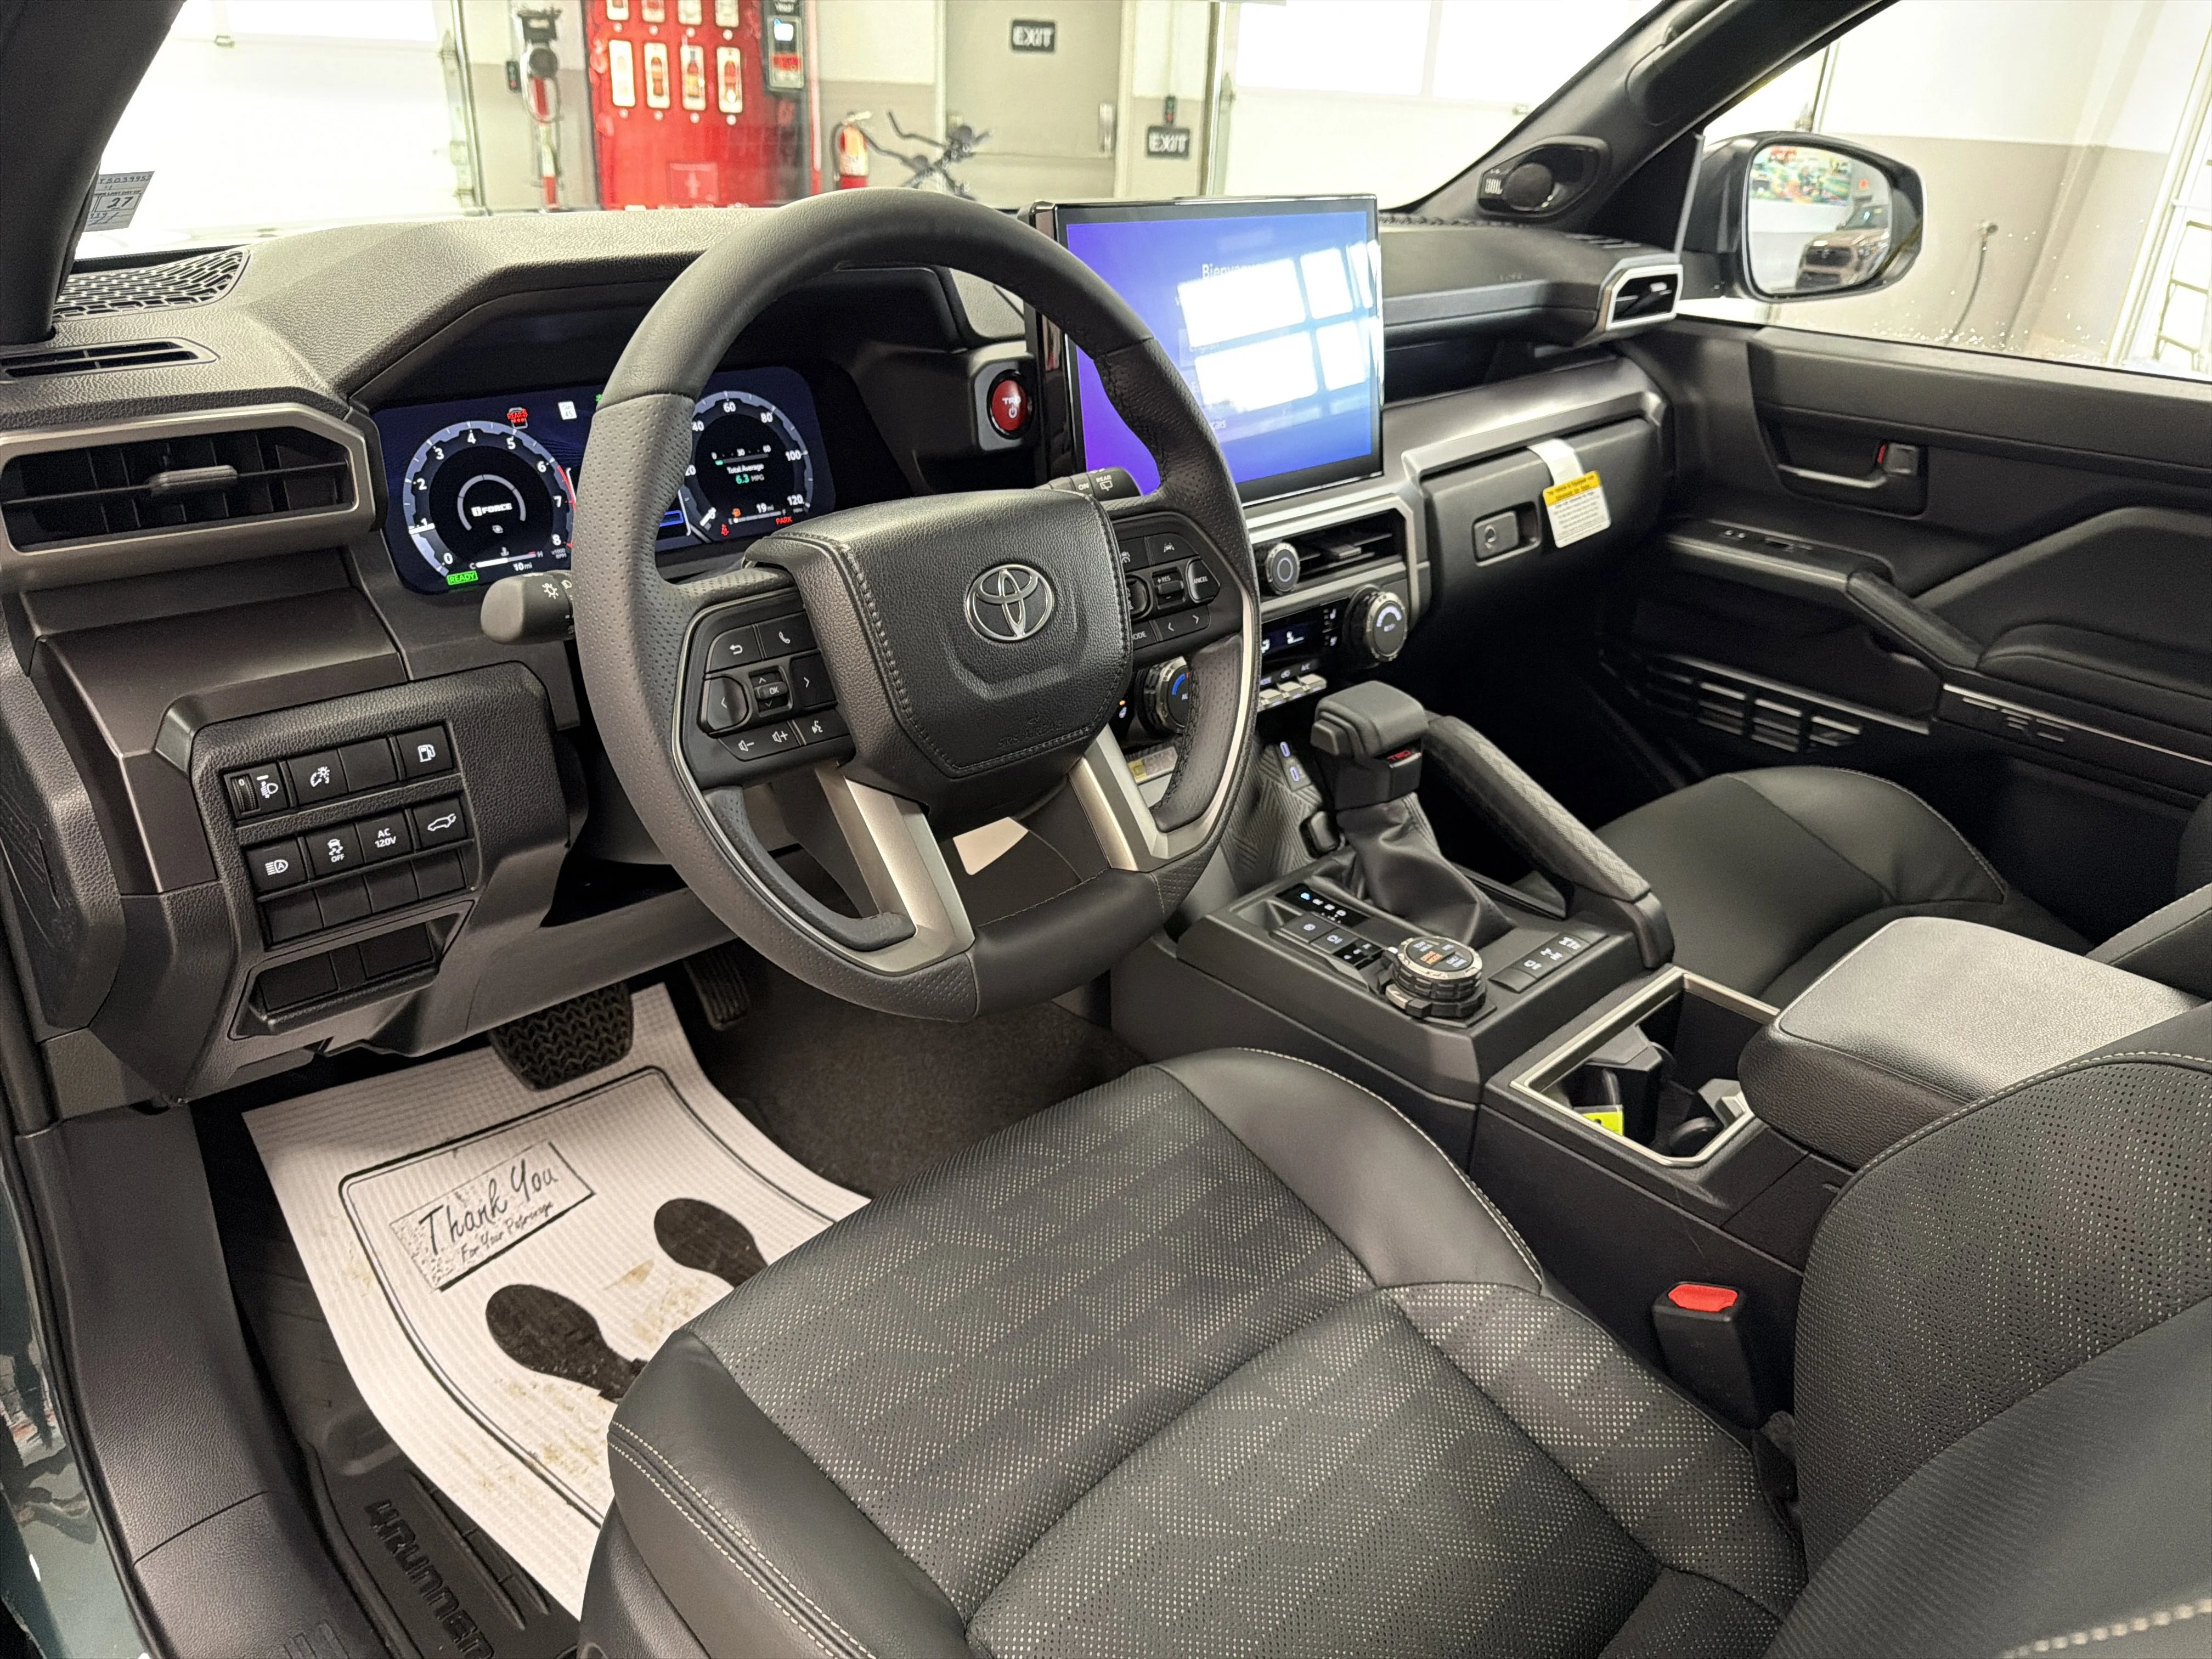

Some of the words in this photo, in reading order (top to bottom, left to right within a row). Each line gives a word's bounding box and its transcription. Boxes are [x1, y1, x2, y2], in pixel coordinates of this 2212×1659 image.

[1013, 26, 1053, 47] EXIT
[1148, 132, 1189, 153] EXIT
[107, 196, 133, 208] 27
[723, 401, 736, 413] 60
[760, 412, 773, 423] 80
[692, 420, 704, 432] 40
[467, 432, 476, 444] 4
[506, 437, 516, 450] 5
[435, 448, 444, 460] 3
[785, 449, 802, 461] 100
[537, 460, 547, 472] 6
[685, 464, 696, 476] 20
[726, 465, 741, 474] Total
[742, 463, 764, 473] Average
[416, 478, 427, 490] 2
[735, 473, 750, 484] 6.3
[751, 474, 765, 482] MPG
[1096, 475, 1112, 483] REAR
[553, 495, 562, 507] 7
[787, 494, 804, 505] 120
[776, 516, 793, 525] PARK
[551, 533, 561, 546] 8
[443, 552, 453, 565] 0
[449, 572, 477, 583] READY
[769, 686, 780, 695] OK
[1387, 750, 1412, 760] TRD
[377, 827, 391, 838] AC
[375, 836, 397, 848] 120V
[331, 853, 345, 862] OFF
[419, 1178, 508, 1255] Thank
[510, 1158, 558, 1203] You
[460, 1243, 479, 1262] For
[481, 1231, 504, 1250] Your
[364, 1499, 494, 1659] 4RUNNER
